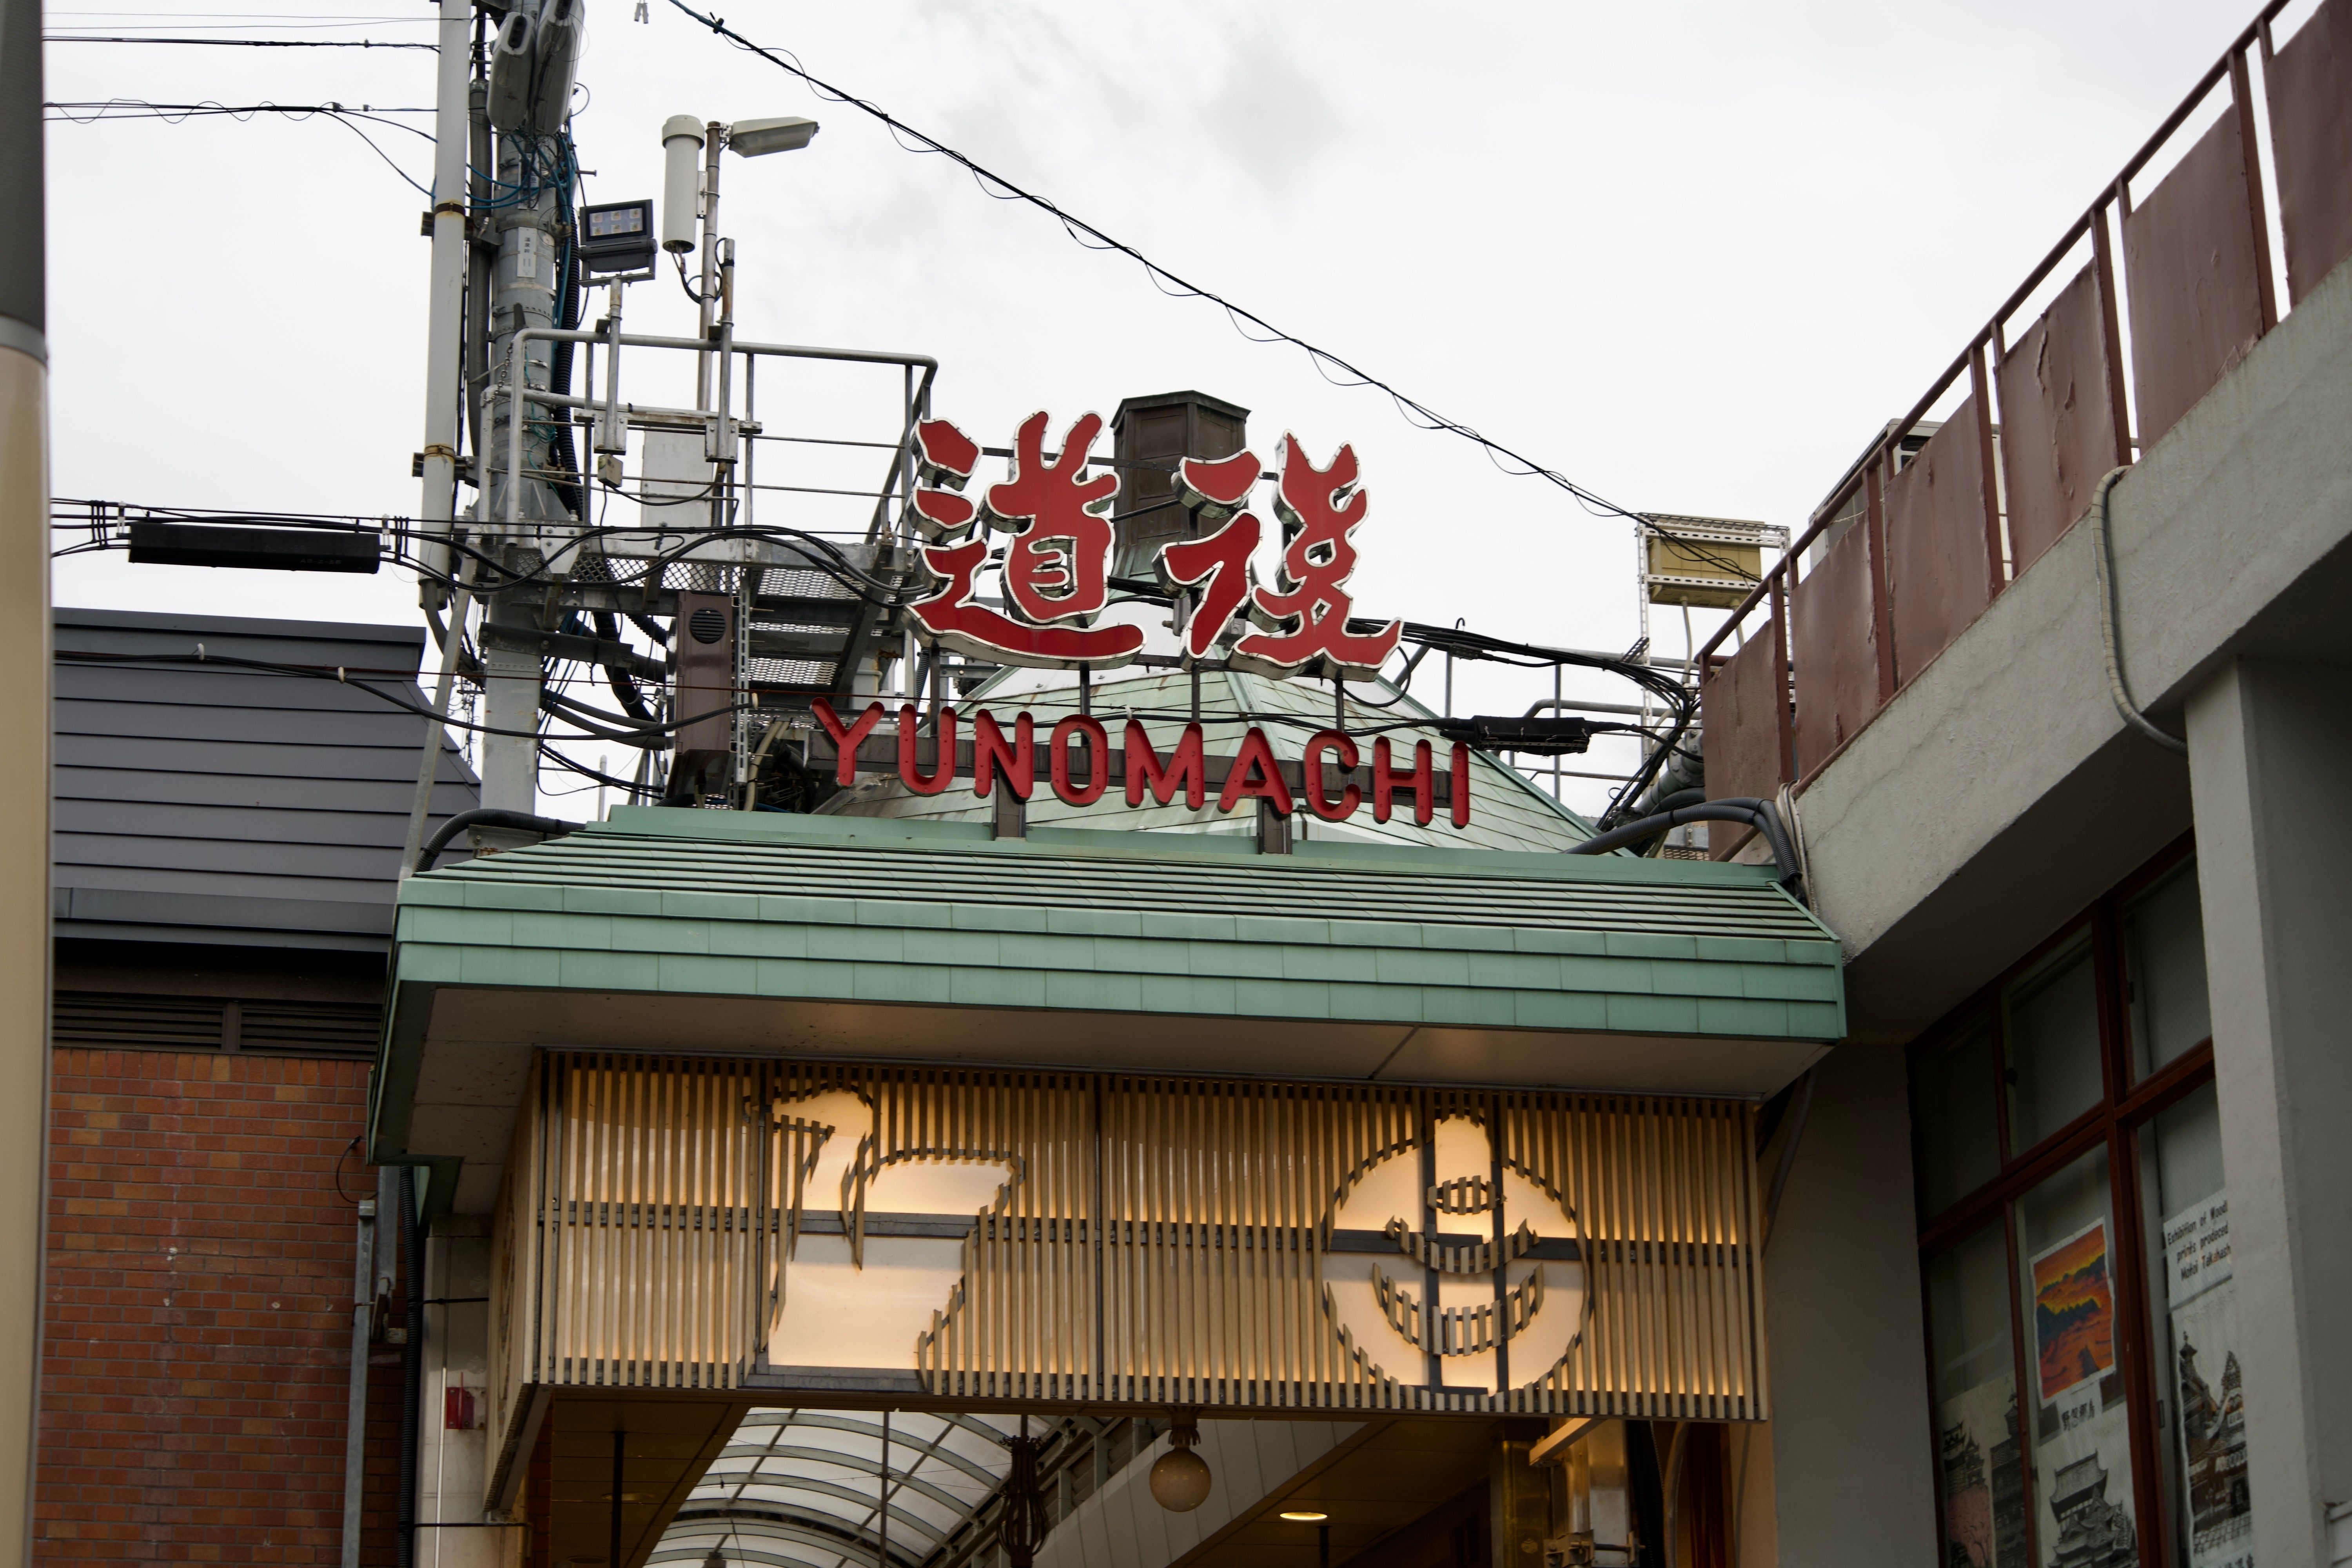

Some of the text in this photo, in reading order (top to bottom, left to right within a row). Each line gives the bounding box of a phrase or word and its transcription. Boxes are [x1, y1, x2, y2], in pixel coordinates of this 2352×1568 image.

[906, 408, 1403, 678] 道後
[811, 697, 1470, 829] YUNOMACHI
[2167, 1200, 2229, 1245] Exhibition of Wood
[2201, 1242, 2232, 1269] Takahash
